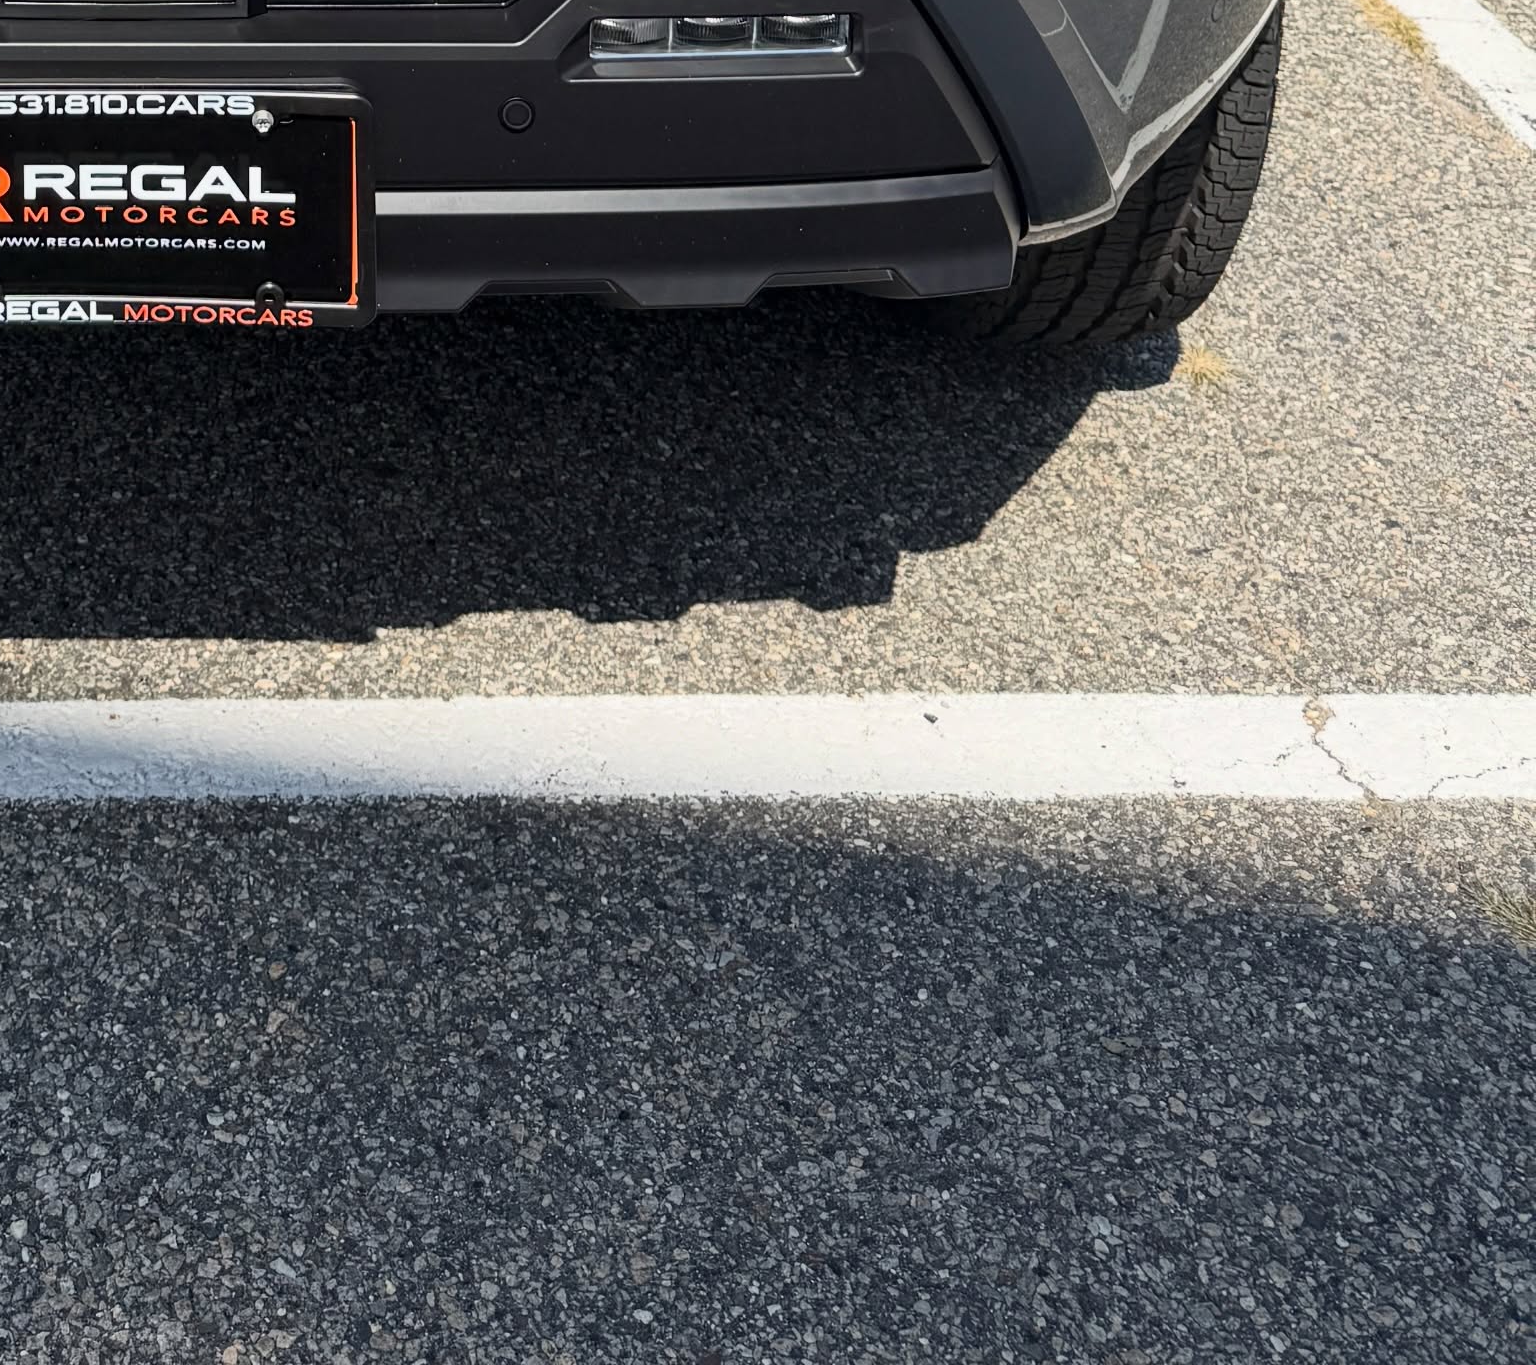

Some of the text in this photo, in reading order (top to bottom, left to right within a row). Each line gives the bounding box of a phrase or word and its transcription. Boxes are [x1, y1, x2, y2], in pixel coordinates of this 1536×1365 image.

[23, 164, 297, 203] REGAL
[23, 205, 297, 227] MOTORCARS
[123, 303, 314, 328] MOTORCARS
